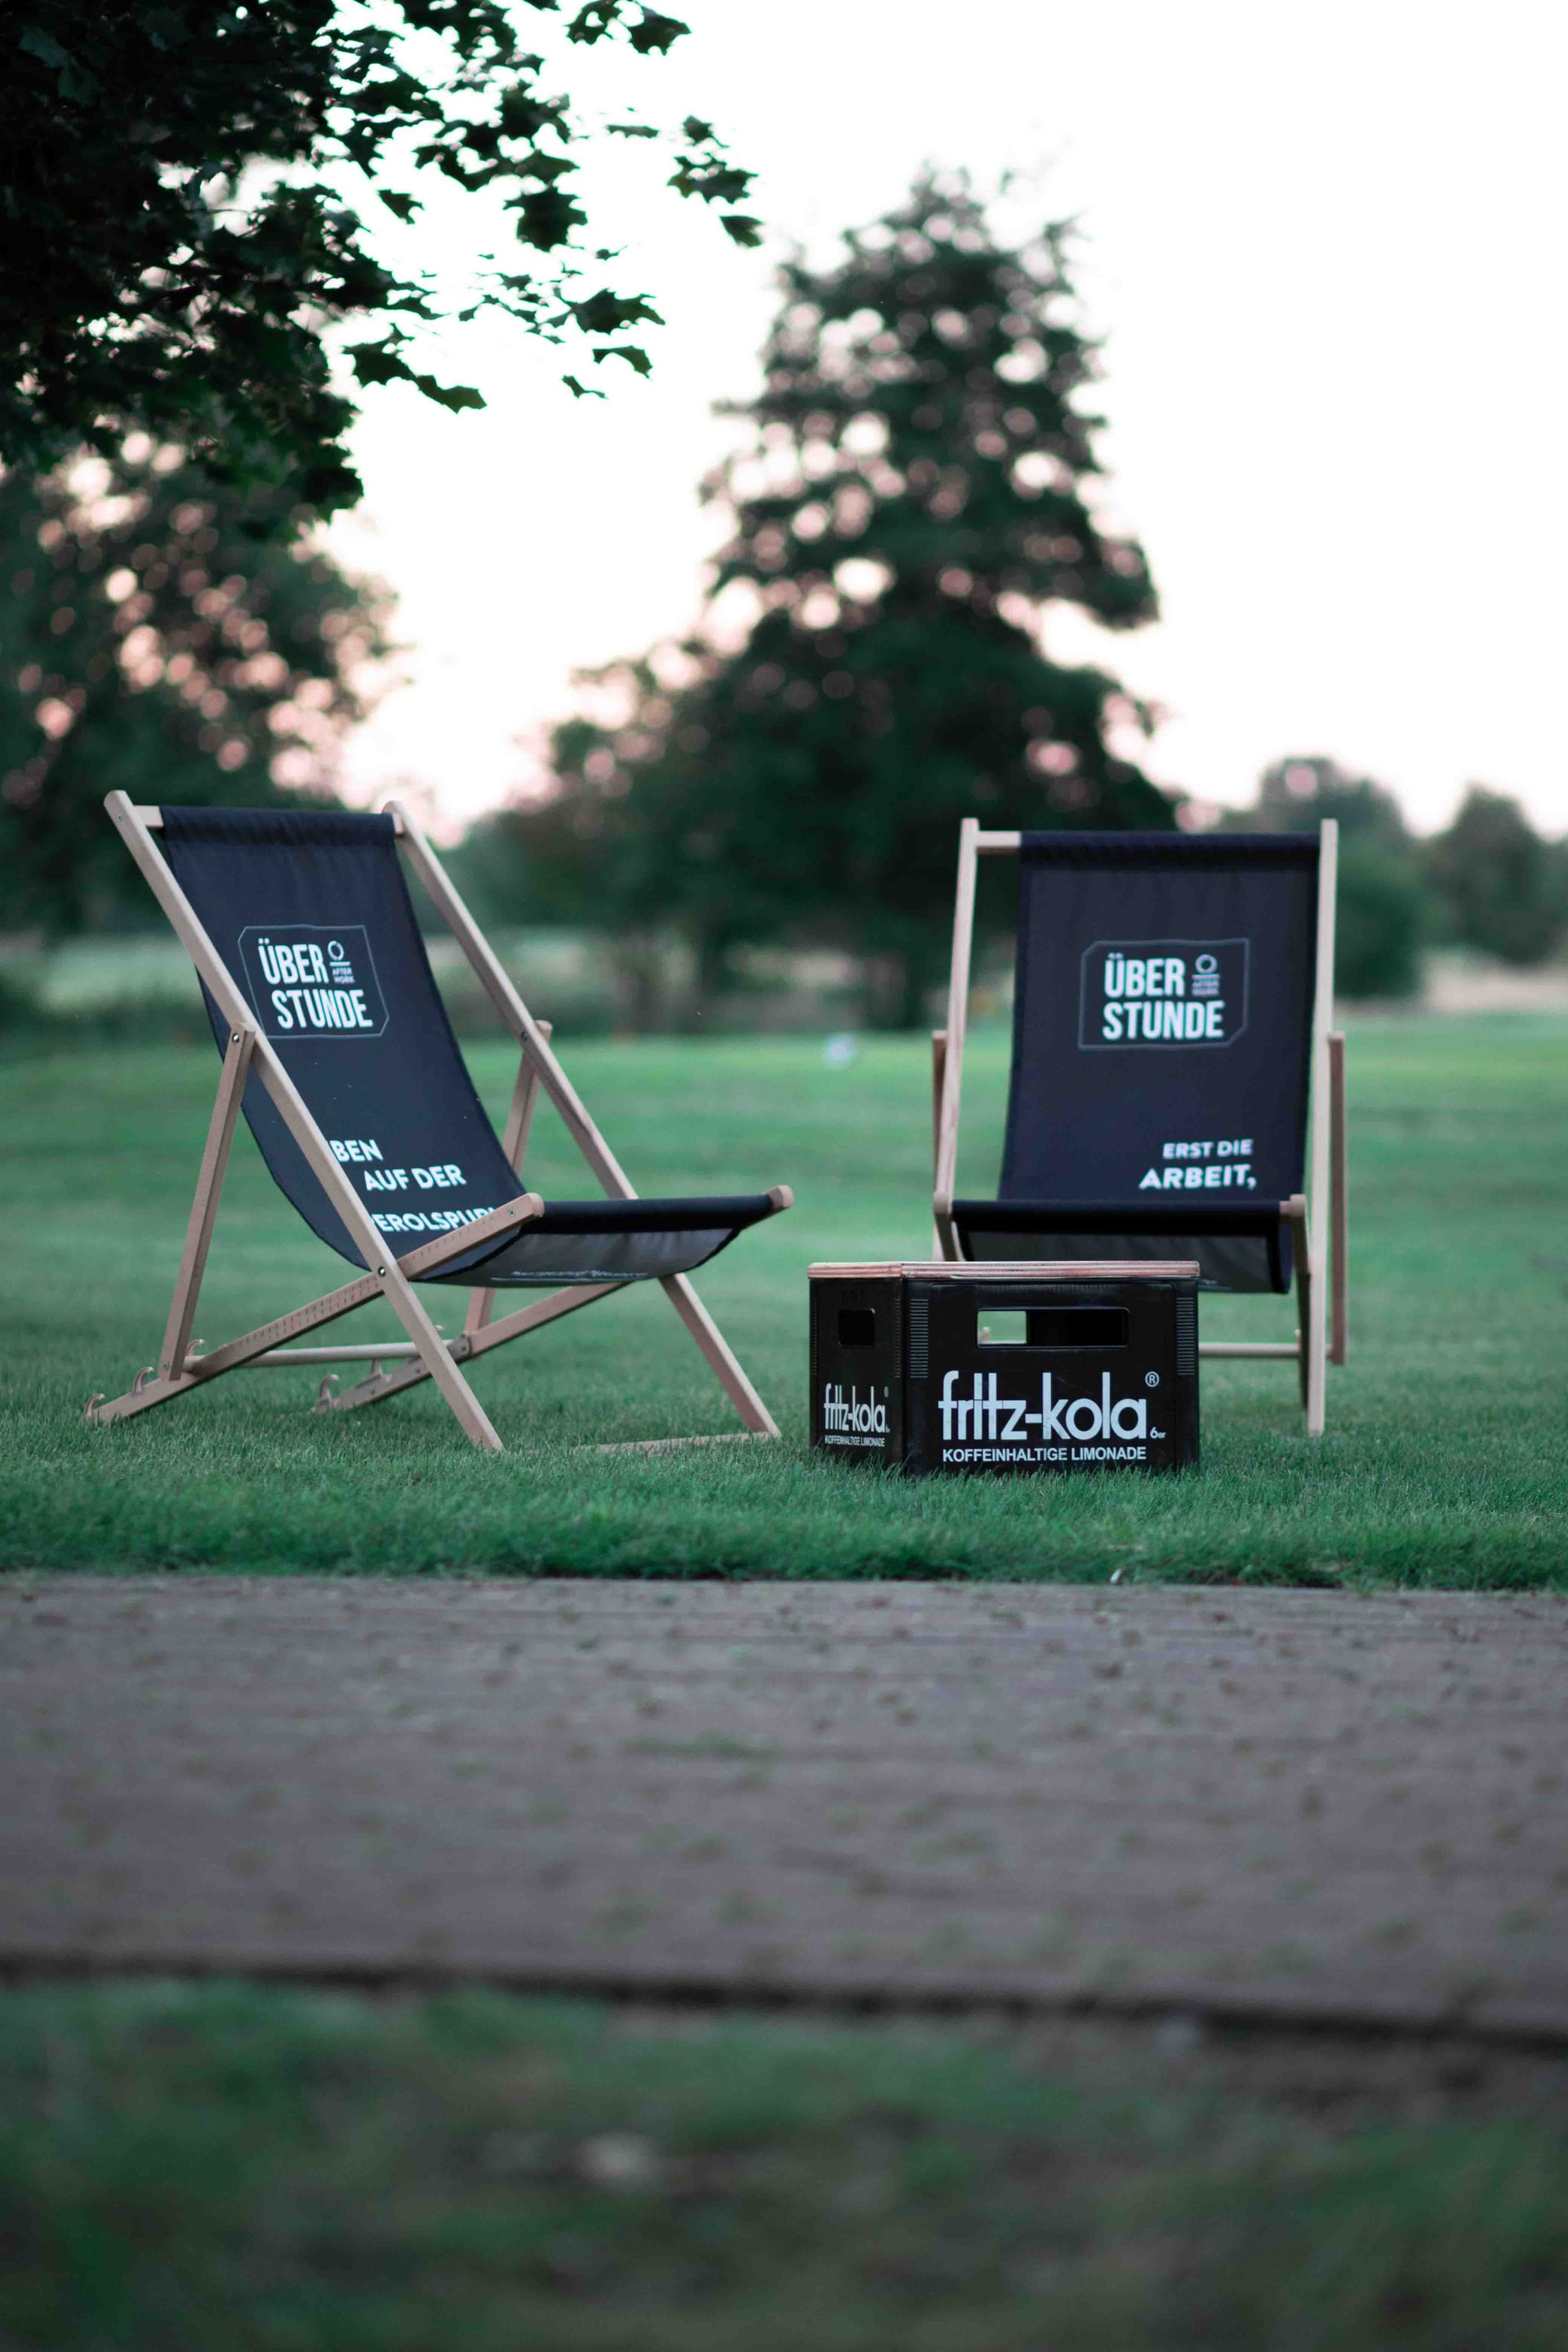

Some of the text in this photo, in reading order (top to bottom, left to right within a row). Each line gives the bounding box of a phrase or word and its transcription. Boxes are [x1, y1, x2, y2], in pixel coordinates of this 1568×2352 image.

[258, 938, 330, 984] ÜBER
[1104, 952, 1185, 998] ÜBER
[271, 989, 373, 1029] STUNDE
[1102, 1000, 1225, 1040] STUNDE
[1162, 1138, 1253, 1159] ERST DIE
[363, 1164, 467, 1191] AUF DER
[1138, 1164, 1257, 1190] ARBEIT,
[823, 1383, 885, 1433] fritz-kola
[938, 1370, 1147, 1441] fritz-kola
[861, 1437, 885, 1447] LIMONADE
[1150, 1427, 1166, 1439] 6er
[942, 1446, 1147, 1462] KOFFEINHALTIGE LIMONADE
